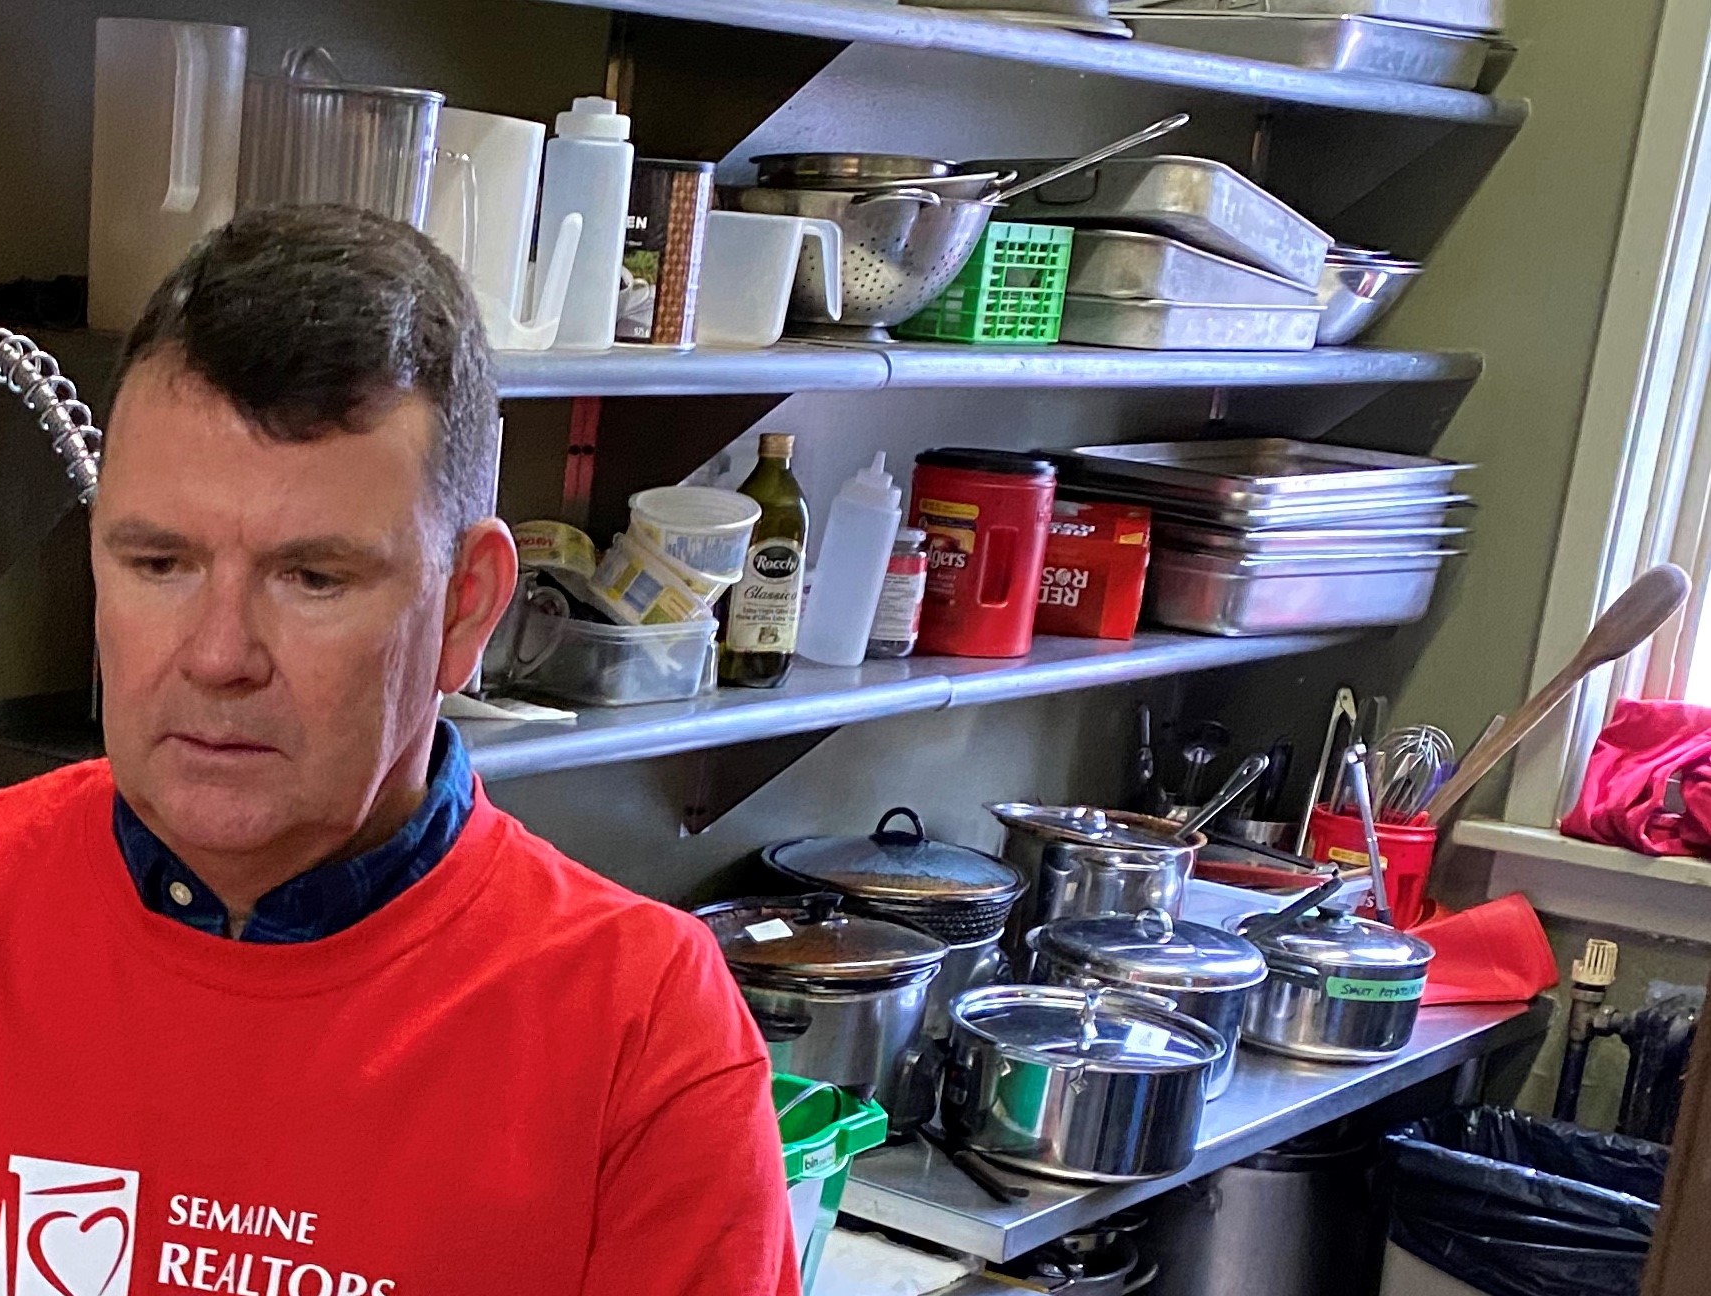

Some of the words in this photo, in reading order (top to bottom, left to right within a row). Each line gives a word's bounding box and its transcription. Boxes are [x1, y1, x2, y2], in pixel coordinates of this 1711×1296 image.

[627, 215, 648, 230] EN
[1042, 566, 1089, 589] ROS
[167, 1193, 319, 1245] SEMAINE
